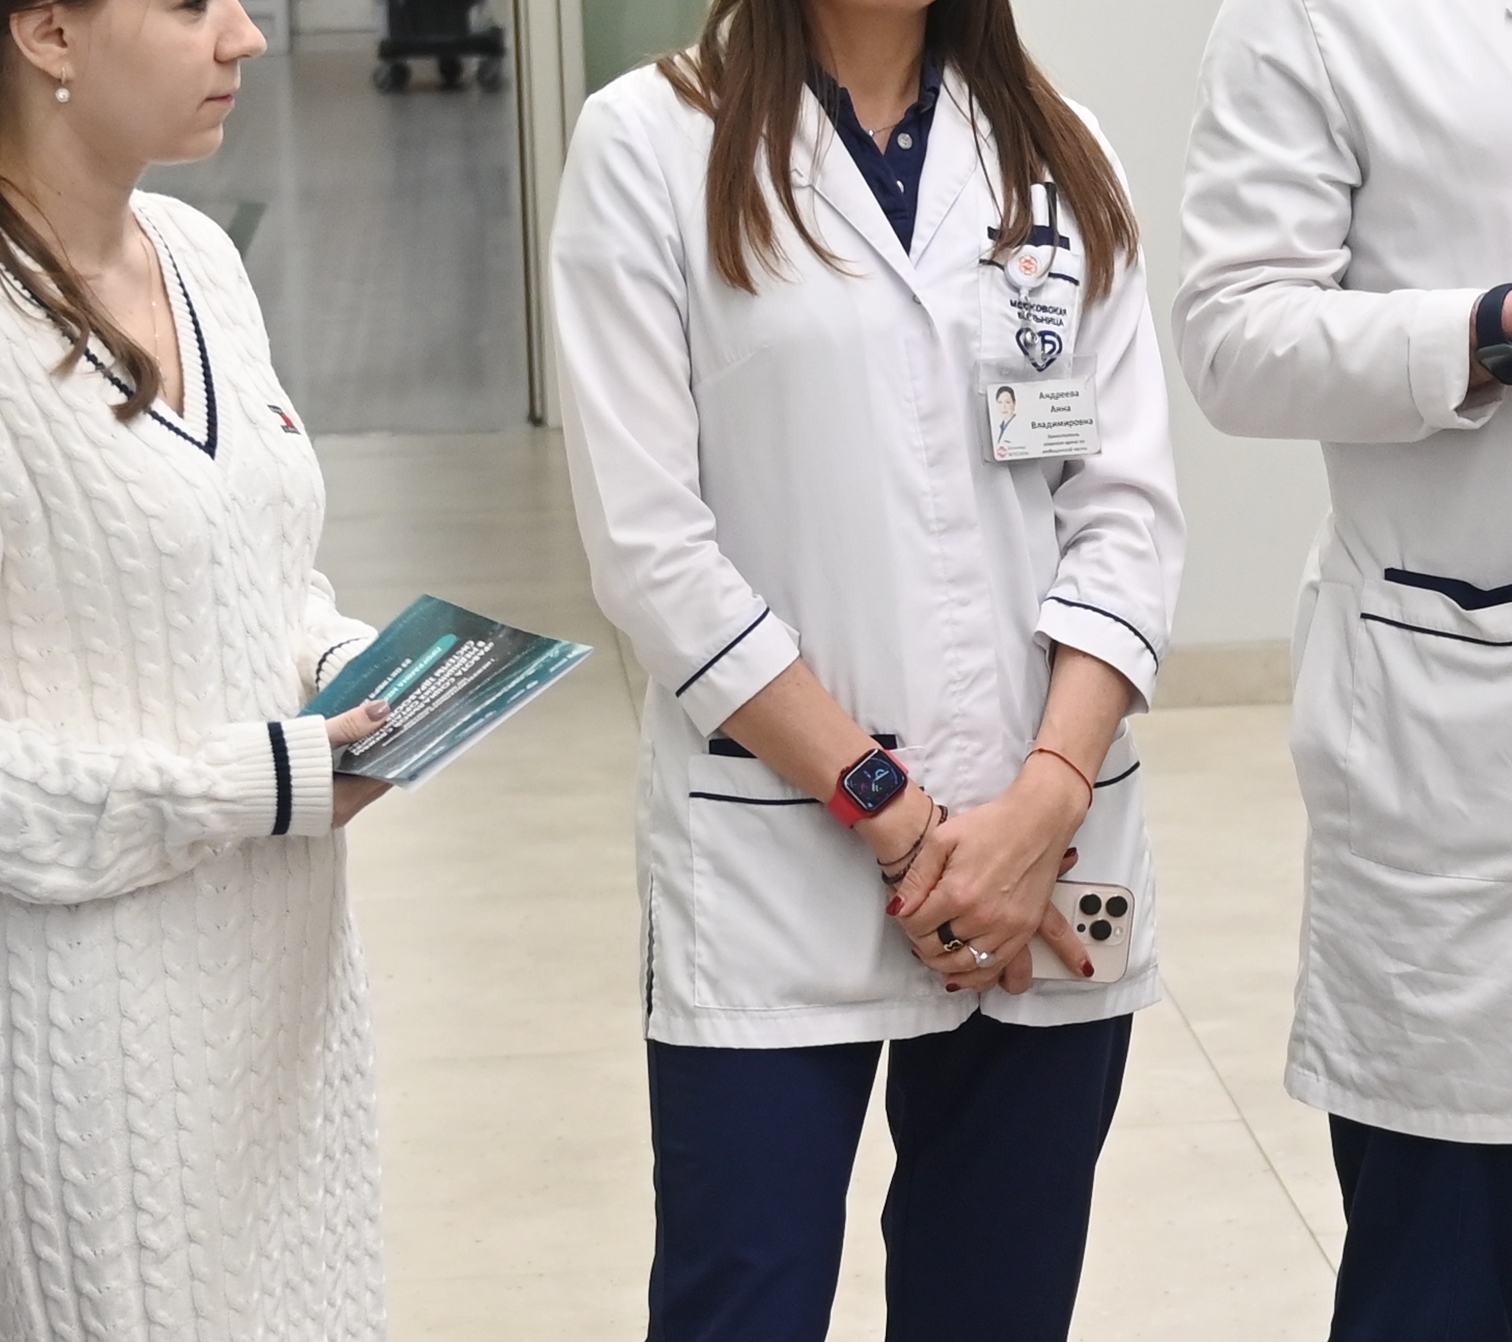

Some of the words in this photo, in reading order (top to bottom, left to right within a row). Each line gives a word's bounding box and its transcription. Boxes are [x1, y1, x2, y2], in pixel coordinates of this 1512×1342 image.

[1038, 389, 1080, 401] Андреева
[1050, 404, 1072, 414] Анна
[1030, 418, 1094, 431] Владимировна
